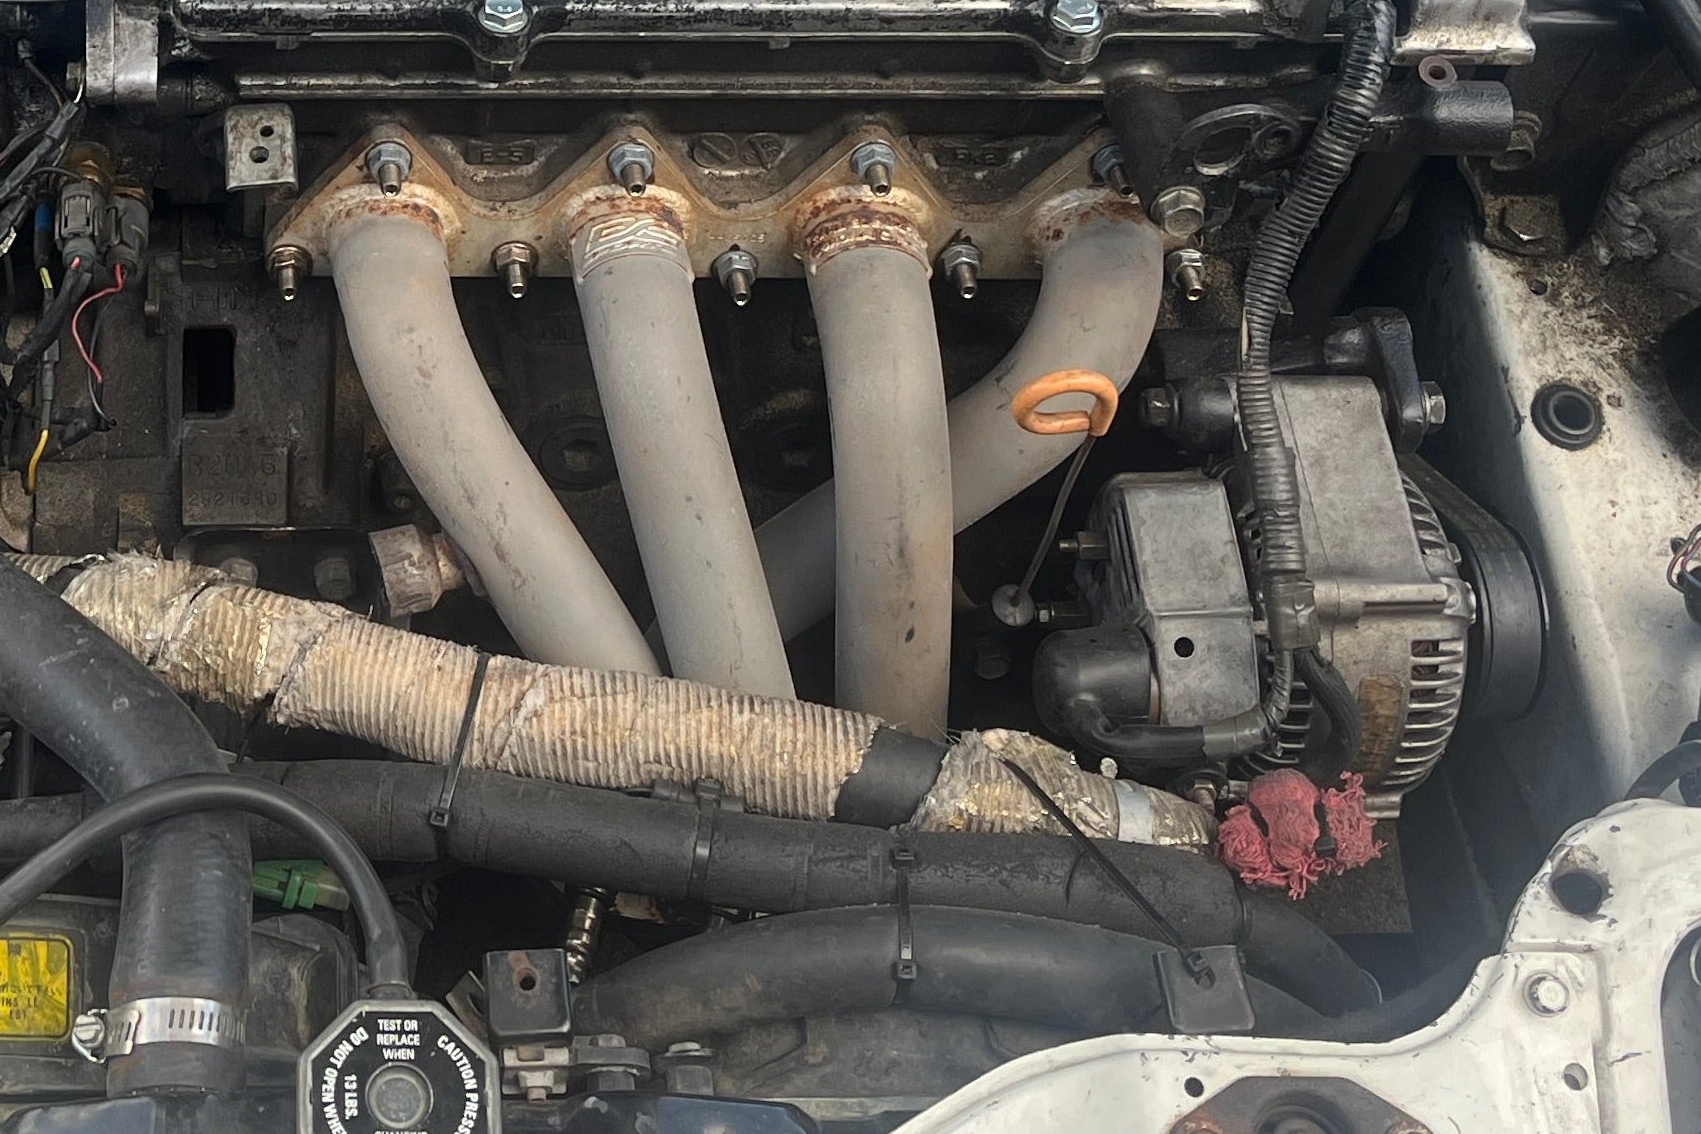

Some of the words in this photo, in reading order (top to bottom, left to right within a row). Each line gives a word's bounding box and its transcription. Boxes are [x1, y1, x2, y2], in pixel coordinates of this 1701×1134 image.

[378, 1019, 402, 1032] TEST
[404, 1019, 418, 1031] OR
[349, 1026, 370, 1047] DO
[377, 1033, 421, 1046] REPLACE
[329, 1039, 354, 1069] NOT
[383, 1048, 415, 1060] WHEN
[437, 1034, 478, 1090] CAUTION
[321, 1067, 339, 1103] OPEN
[344, 1074, 358, 1091] 13
[344, 1092, 359, 1120] LBS.
